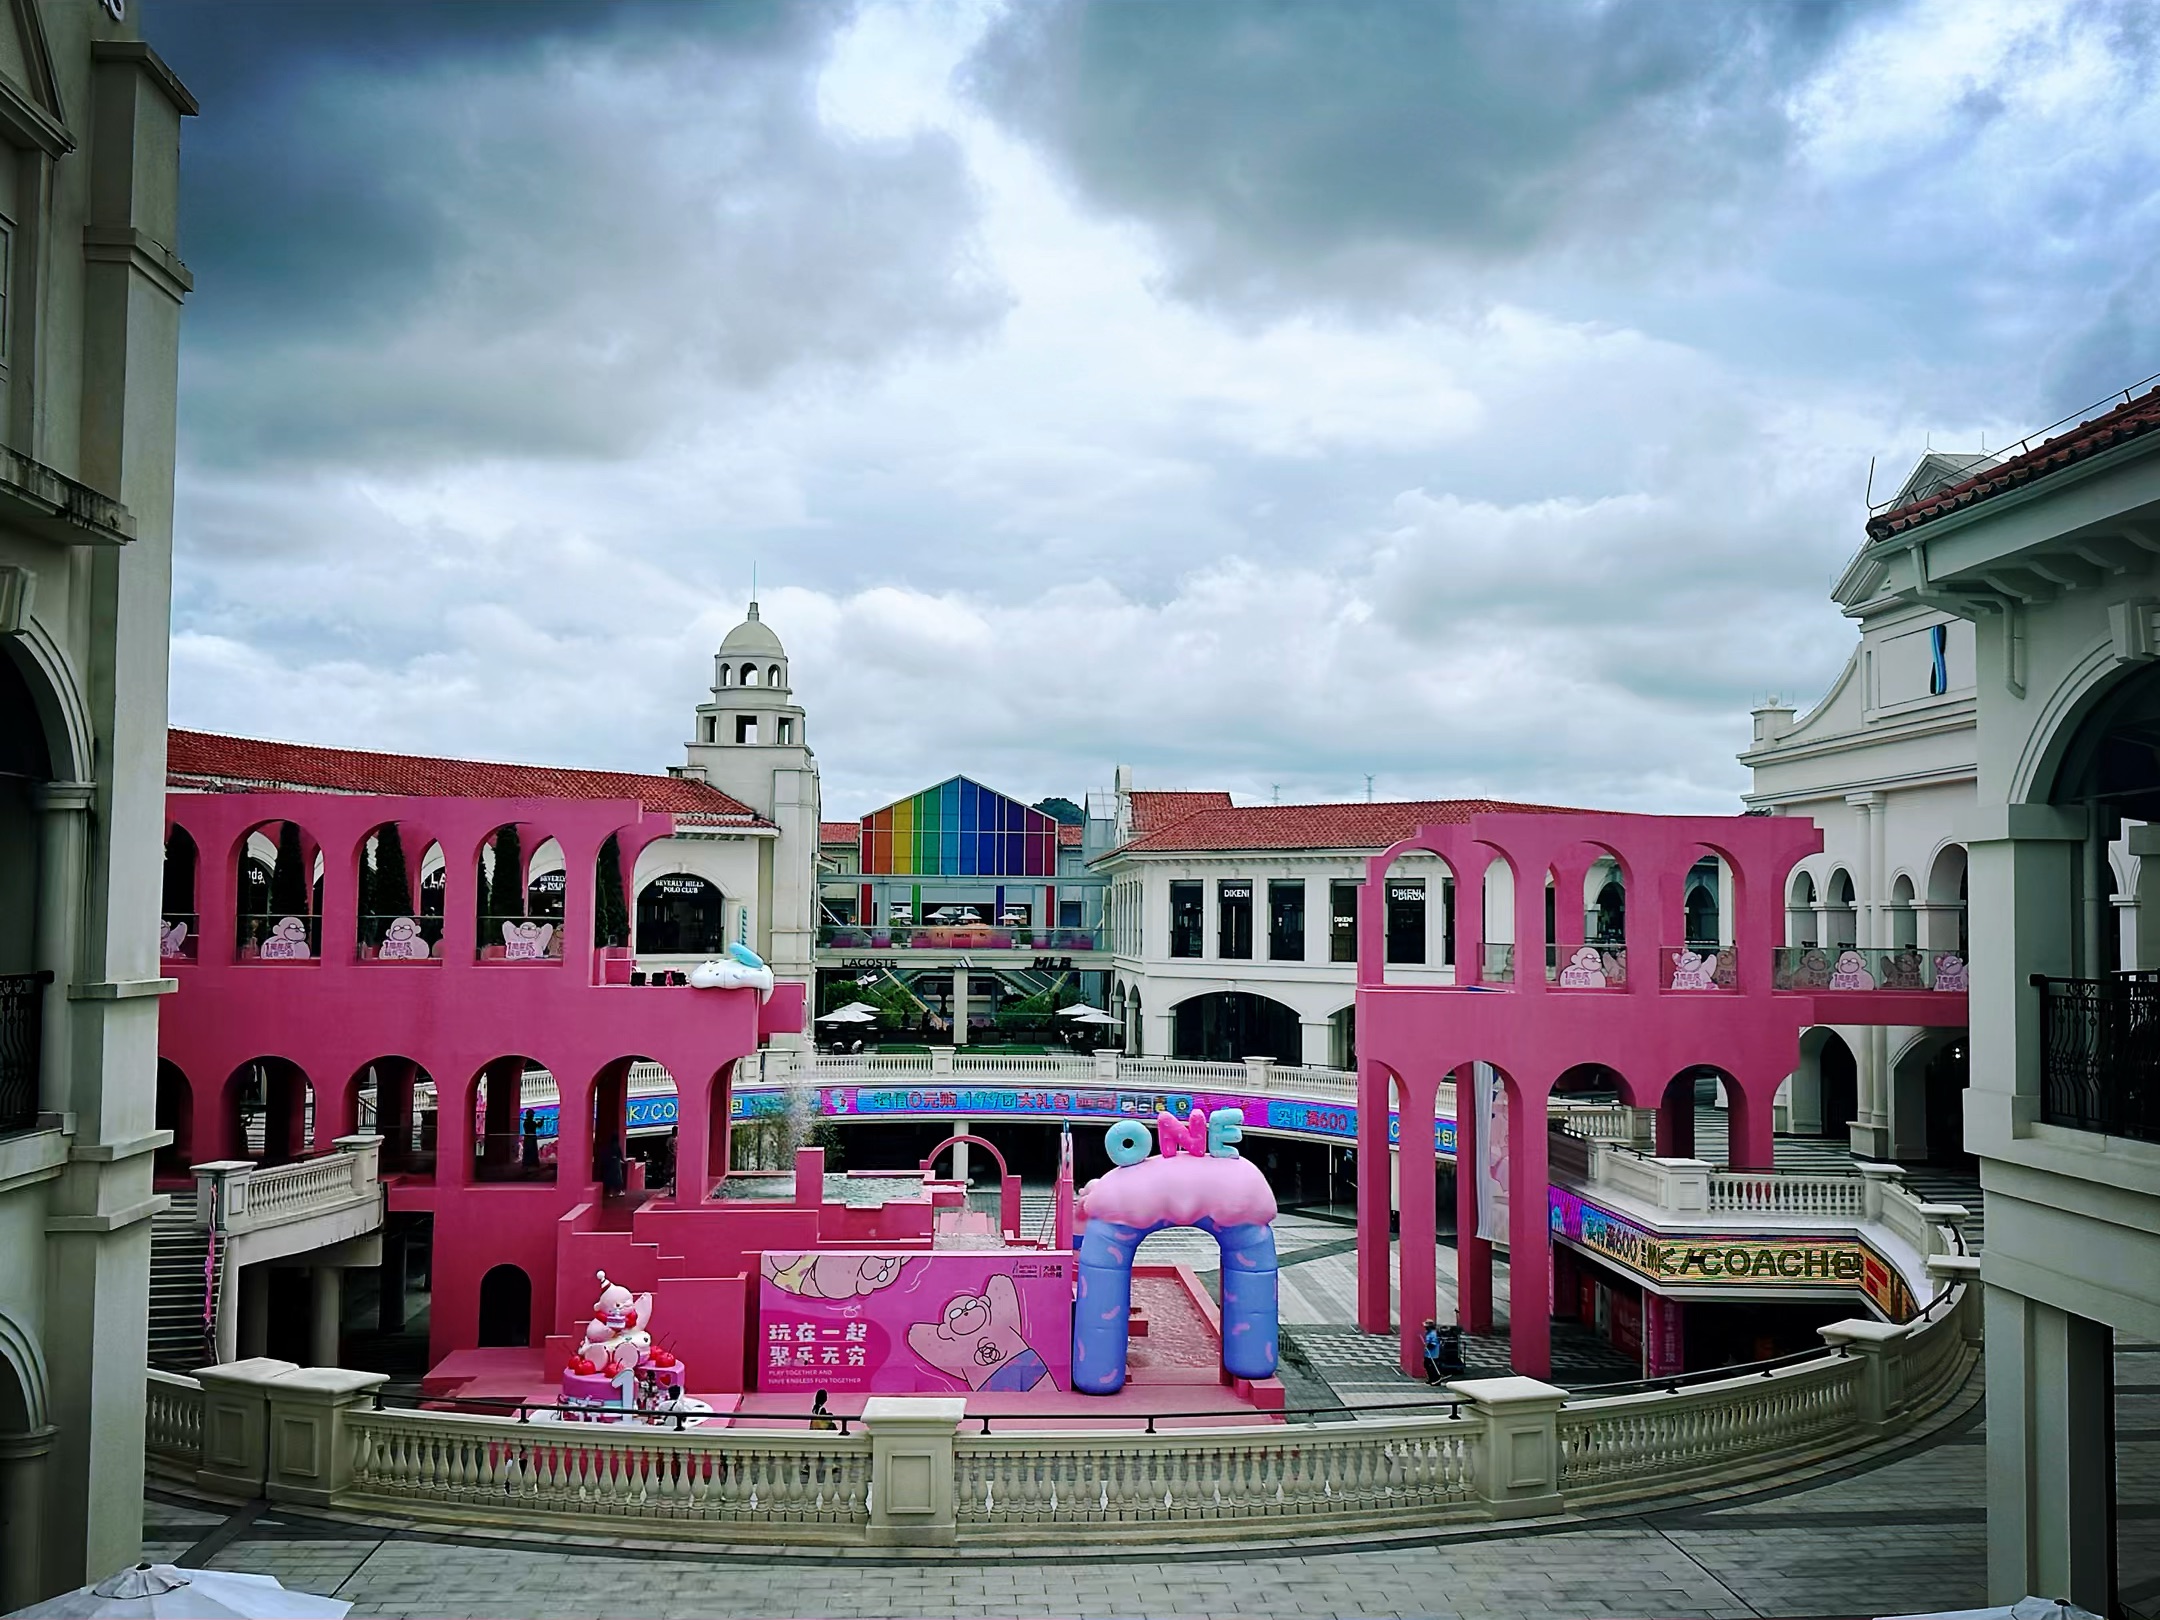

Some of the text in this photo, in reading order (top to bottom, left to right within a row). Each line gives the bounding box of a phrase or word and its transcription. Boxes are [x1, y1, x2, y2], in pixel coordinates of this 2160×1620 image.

[685, 880, 704, 888] HILLS
[1224, 889, 1250, 898] DIKENI
[841, 958, 898, 969] LACOSTE
[1032, 956, 1073, 970] MLB
[1104, 1108, 1244, 1168] ONE
[768, 1322, 868, 1342] 玩在一起
[768, 1345, 867, 1367] 聚乐无穷
